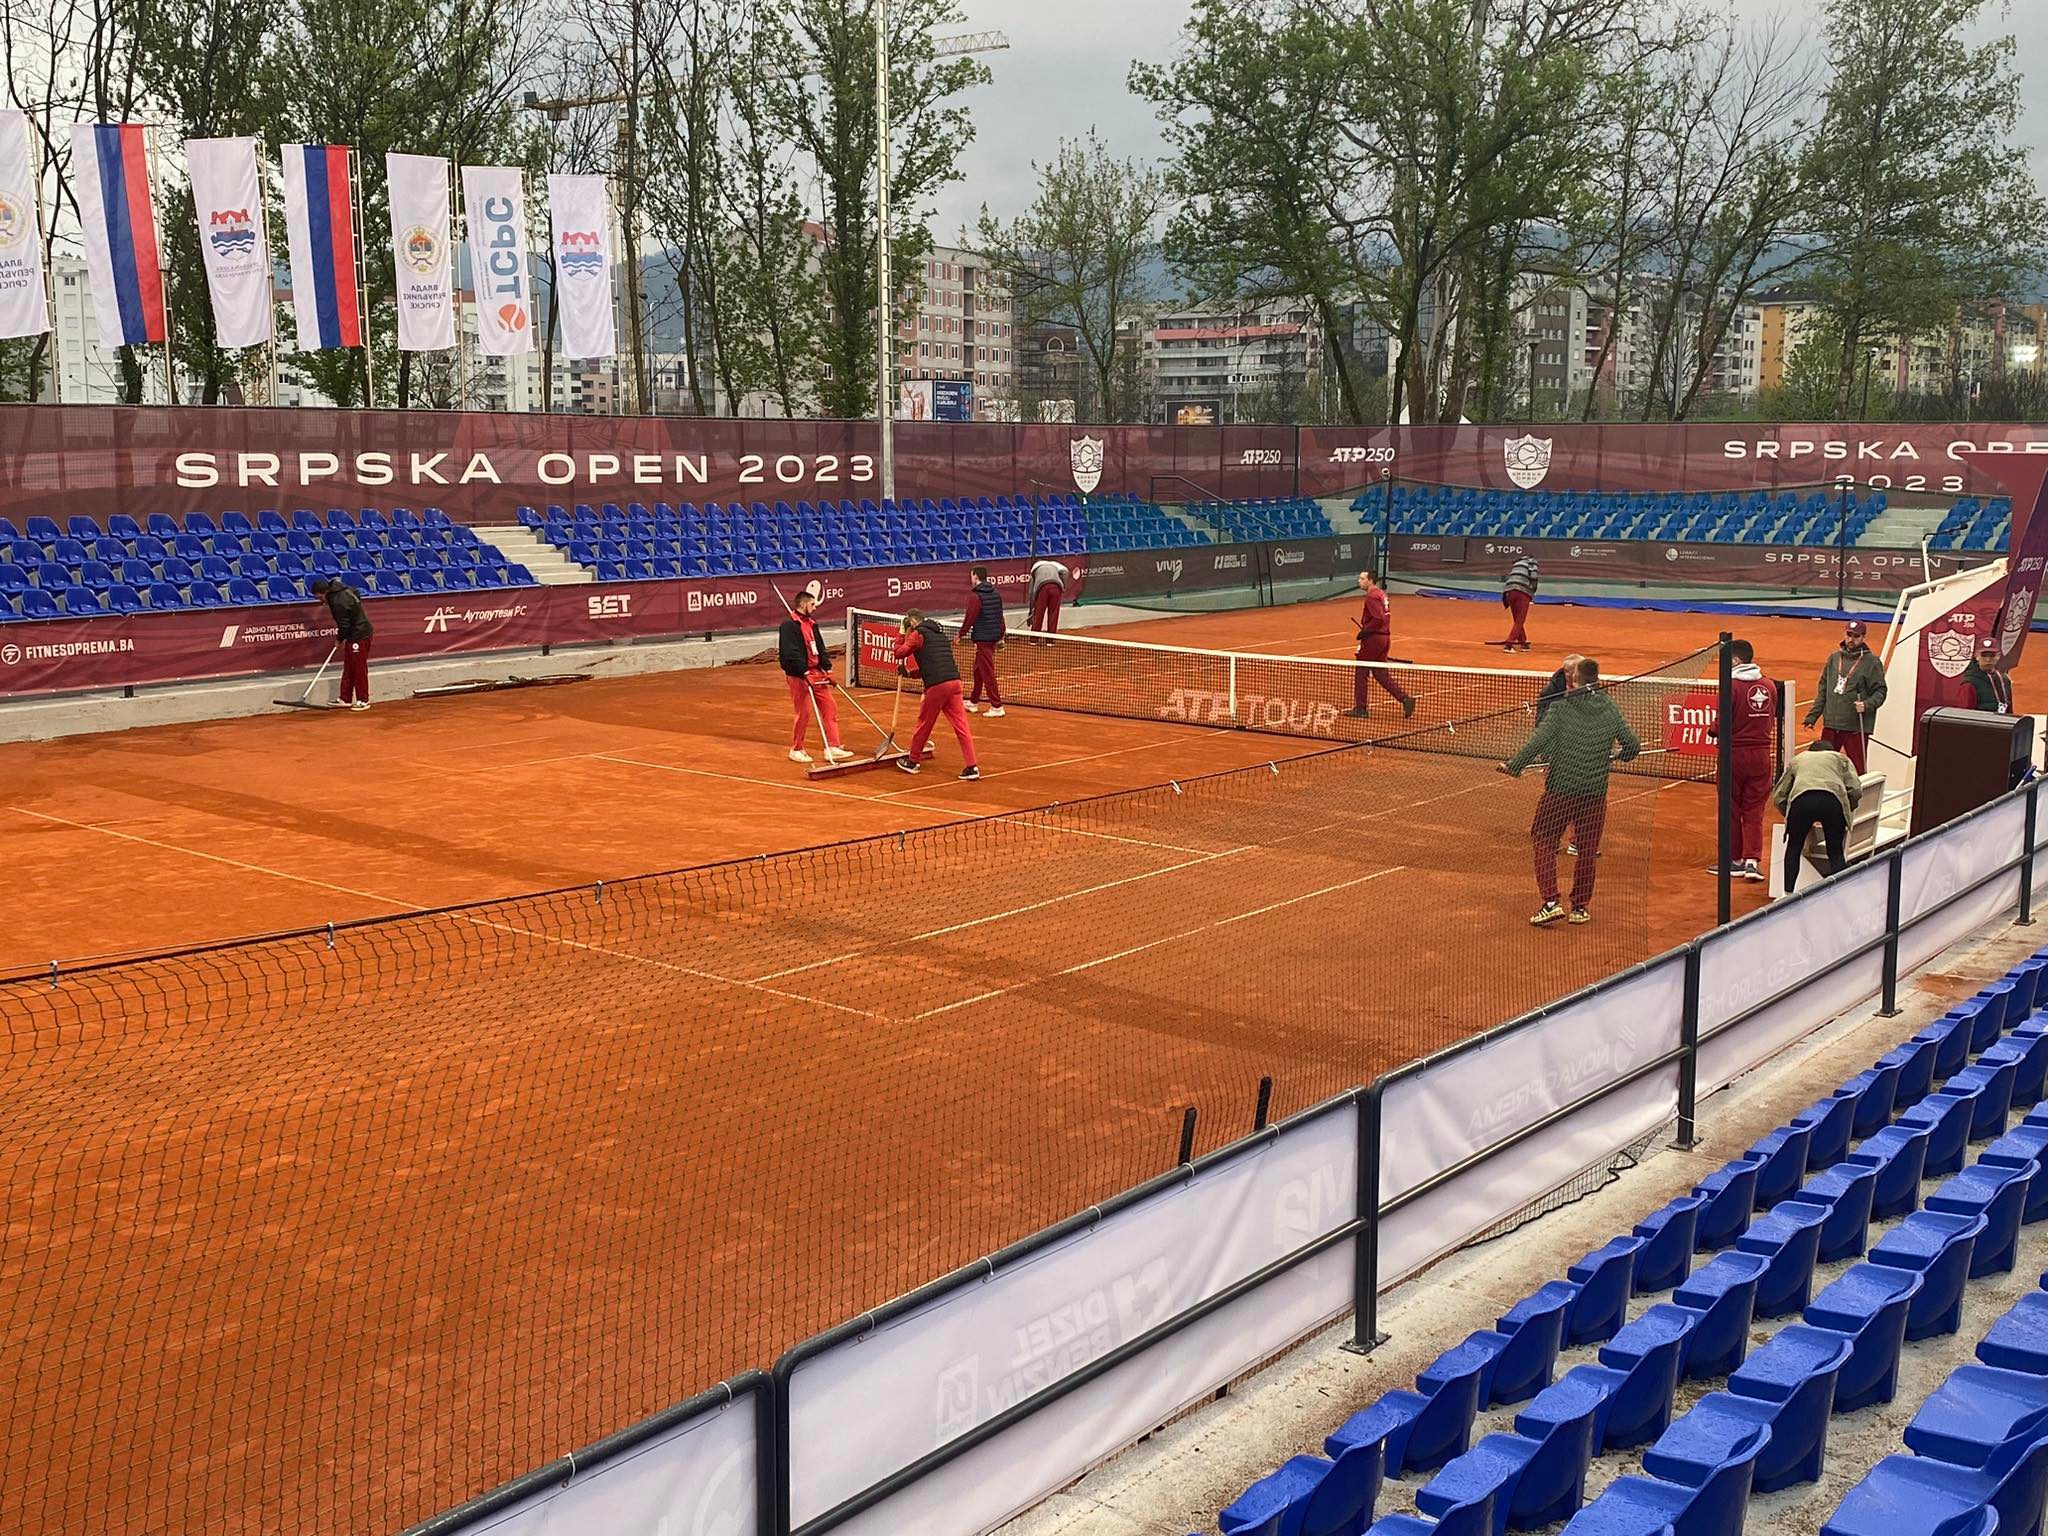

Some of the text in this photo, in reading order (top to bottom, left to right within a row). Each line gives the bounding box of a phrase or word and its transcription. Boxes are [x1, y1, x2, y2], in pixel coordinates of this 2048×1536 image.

[1723, 440, 1920, 460] SRPSKA
[174, 451, 874, 488] SRPSKA OPEN 2023
[1834, 474, 1965, 492] 2023
[1764, 552, 1942, 568] SRPSKA OPEN
[997, 574, 1015, 585] EURO
[1818, 569, 1882, 580] 2023
[902, 580, 932, 591] 3D BOX
[588, 594, 631, 614] SET
[702, 591, 758, 607] MG MIND
[463, 607, 513, 624] Аутопутеви
[1948, 613, 1975, 623] ATP
[275, 629, 320, 641] РЕПУБЛИКЕ
[25, 638, 135, 659] FITNESOPREMA.BA
[870, 647, 882, 661] FLY
[1244, 694, 1340, 736] TOUR
[1682, 727, 1703, 744] FLY
